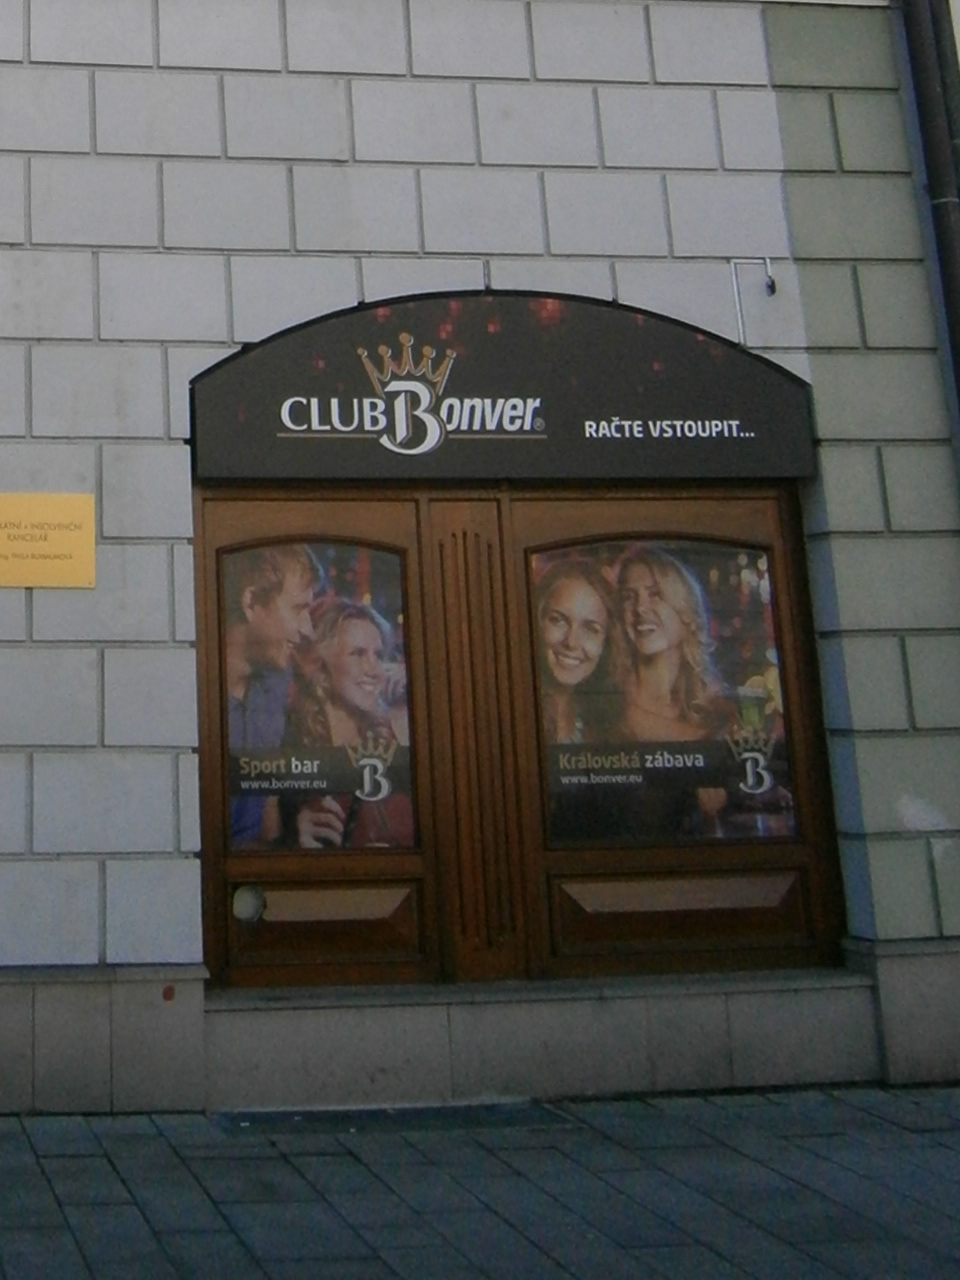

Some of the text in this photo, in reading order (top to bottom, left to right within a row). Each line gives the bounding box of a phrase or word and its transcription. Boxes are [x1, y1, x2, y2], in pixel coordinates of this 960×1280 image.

[279, 380, 543, 456] CLUB Bonver
[584, 416, 756, 439] RAČTE VSTOUPIT...
[239, 756, 321, 777] Sport bar
[559, 750, 706, 770] Královská zábava
[240, 777, 327, 790] www.bonver.eu
[560, 773, 644, 785] www.bonver.eu
